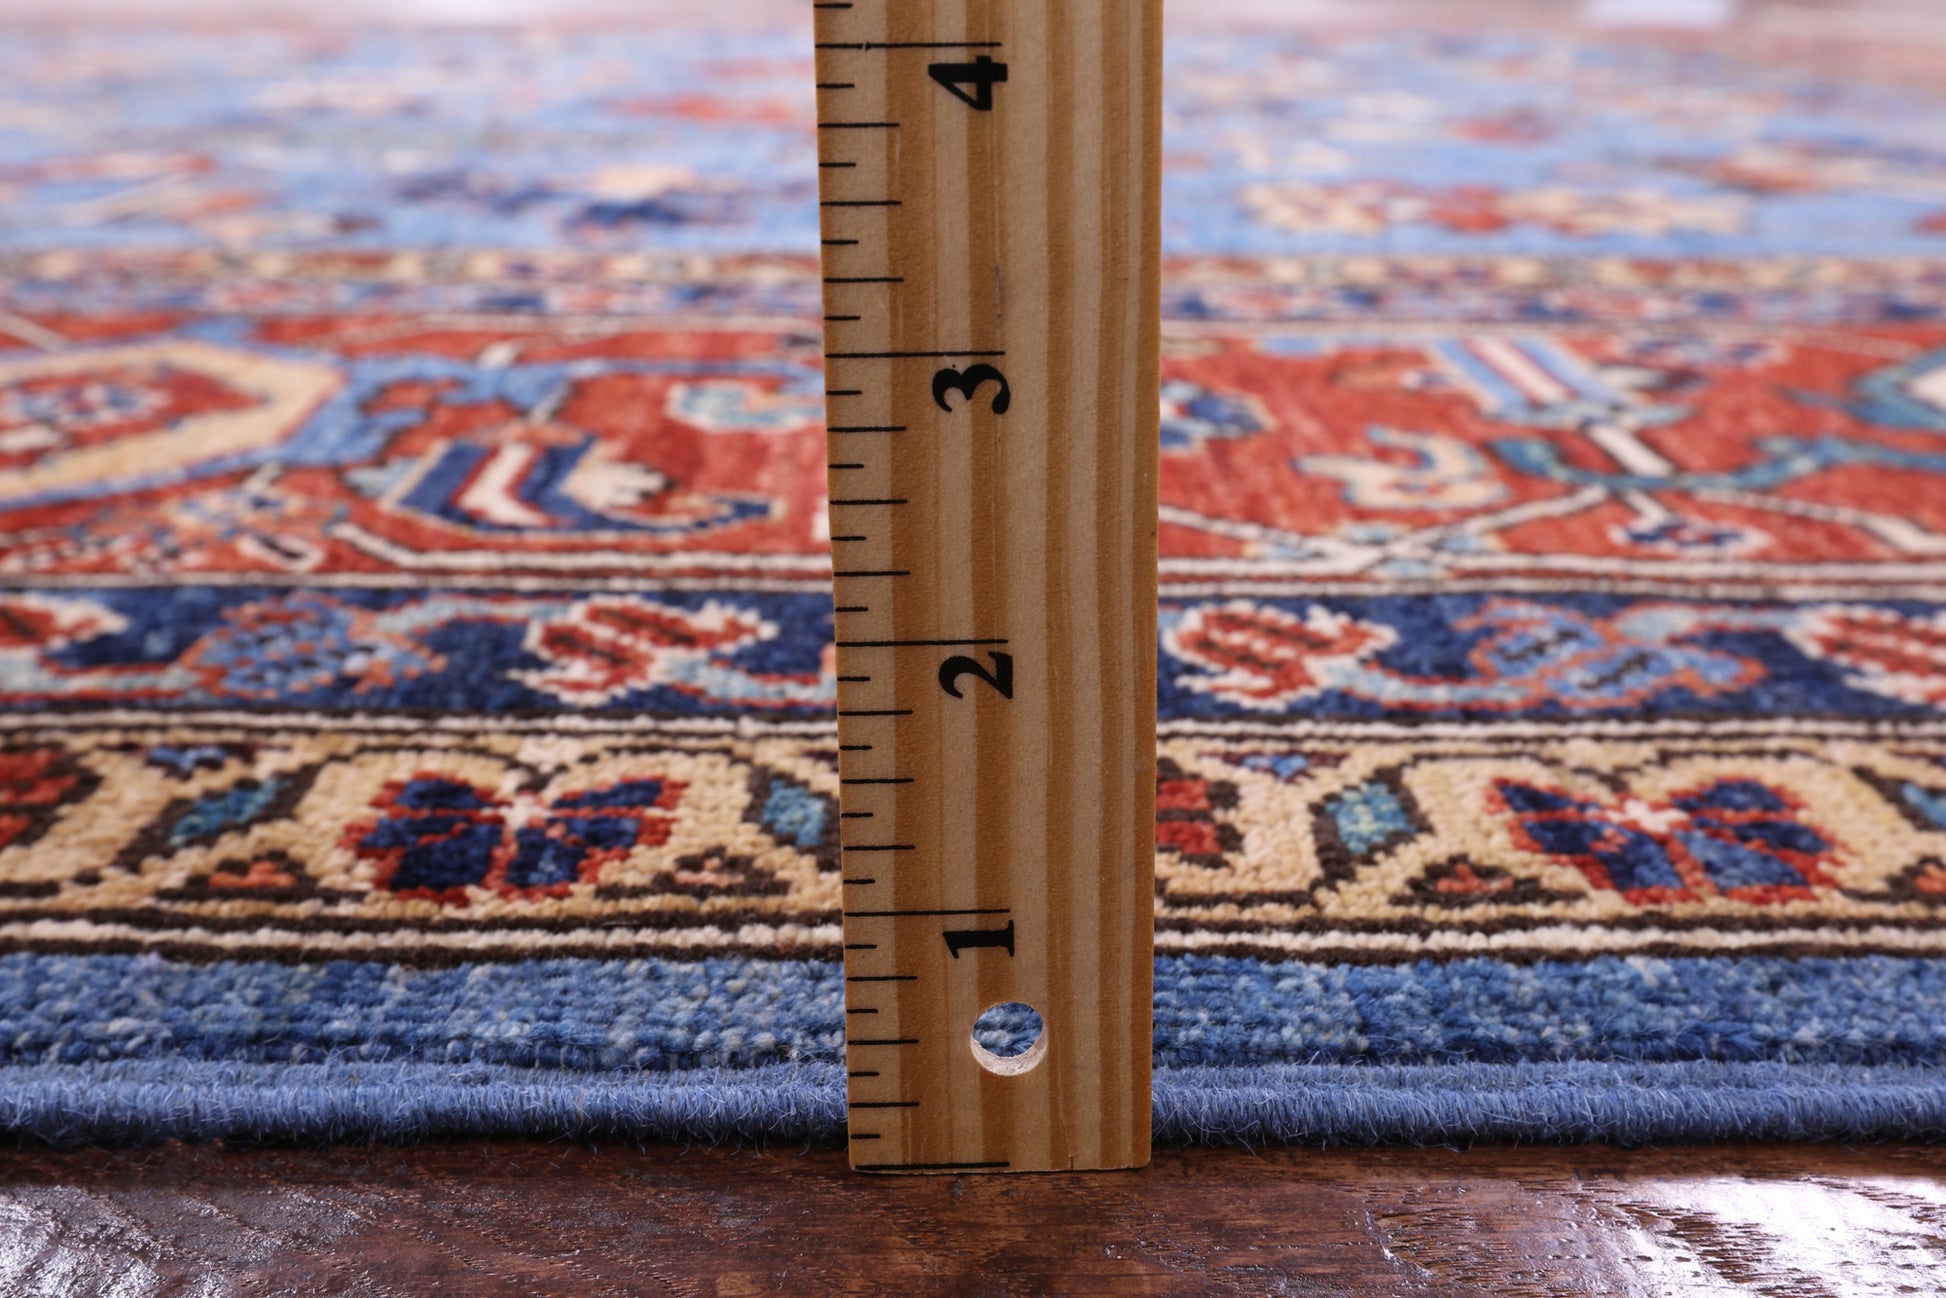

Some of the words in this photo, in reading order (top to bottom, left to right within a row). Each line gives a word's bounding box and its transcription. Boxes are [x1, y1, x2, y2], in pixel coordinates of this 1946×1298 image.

[928, 55, 1008, 111] 4
[932, 363, 1010, 415] 3
[938, 651, 1013, 699] 2
[942, 920, 1015, 959] 1
